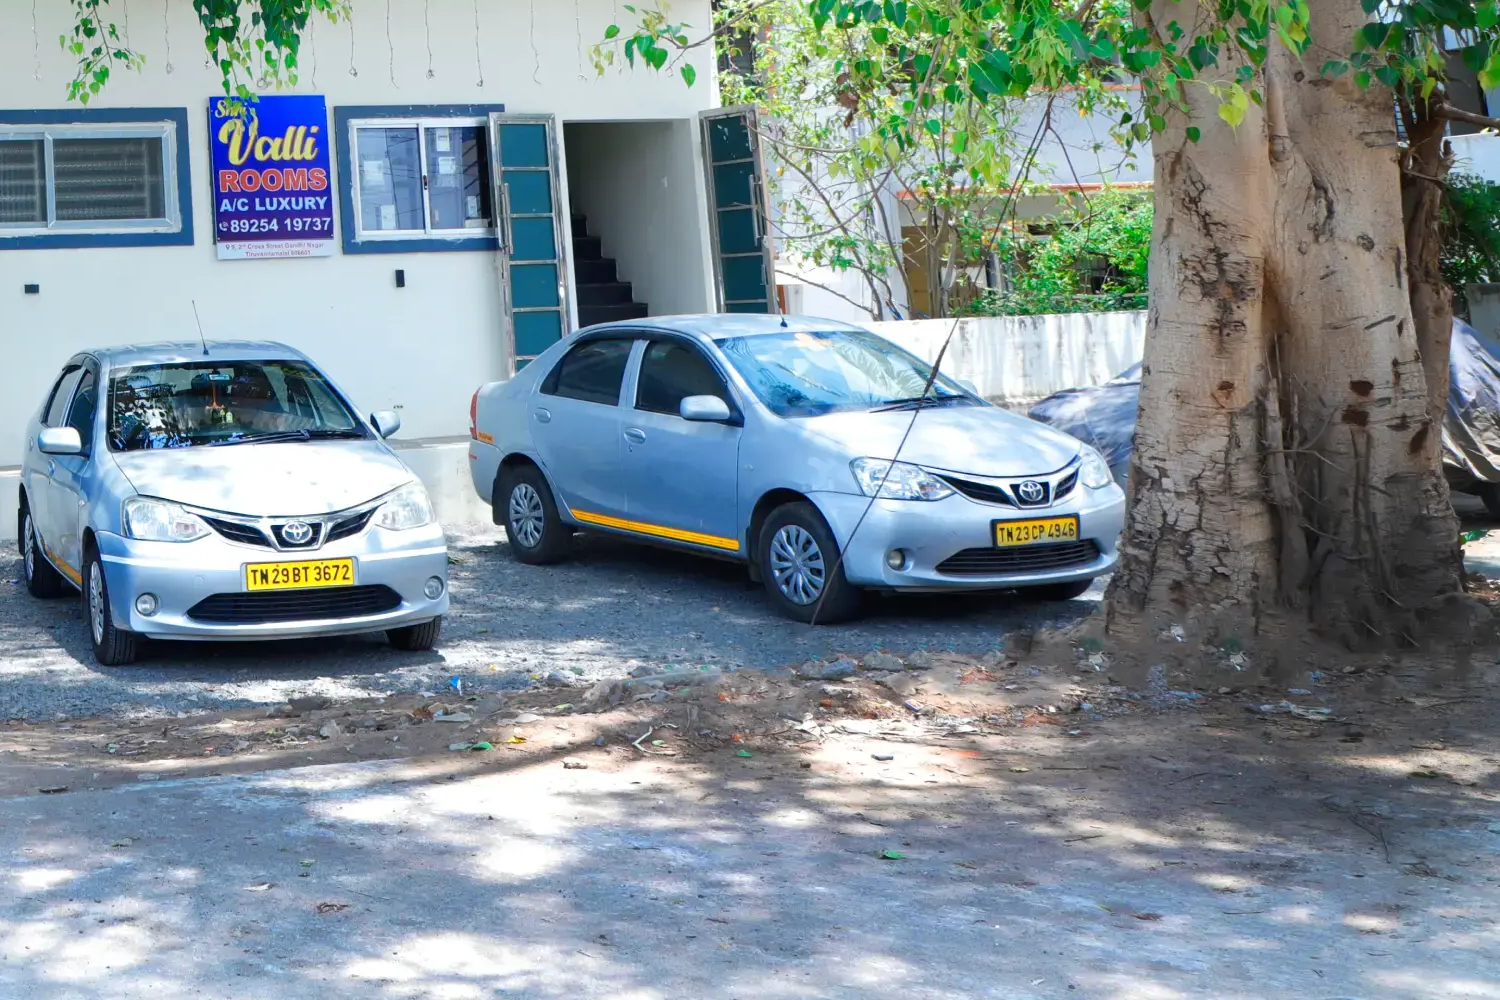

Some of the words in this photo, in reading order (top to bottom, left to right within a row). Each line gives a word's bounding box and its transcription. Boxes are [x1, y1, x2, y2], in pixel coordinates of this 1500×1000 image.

[218, 116, 320, 166] Valli
[219, 168, 328, 192] ROOMS
[220, 198, 249, 212] A/C
[255, 196, 328, 211] LUXURY
[230, 218, 279, 233] 89254
[284, 217, 331, 231] 19737
